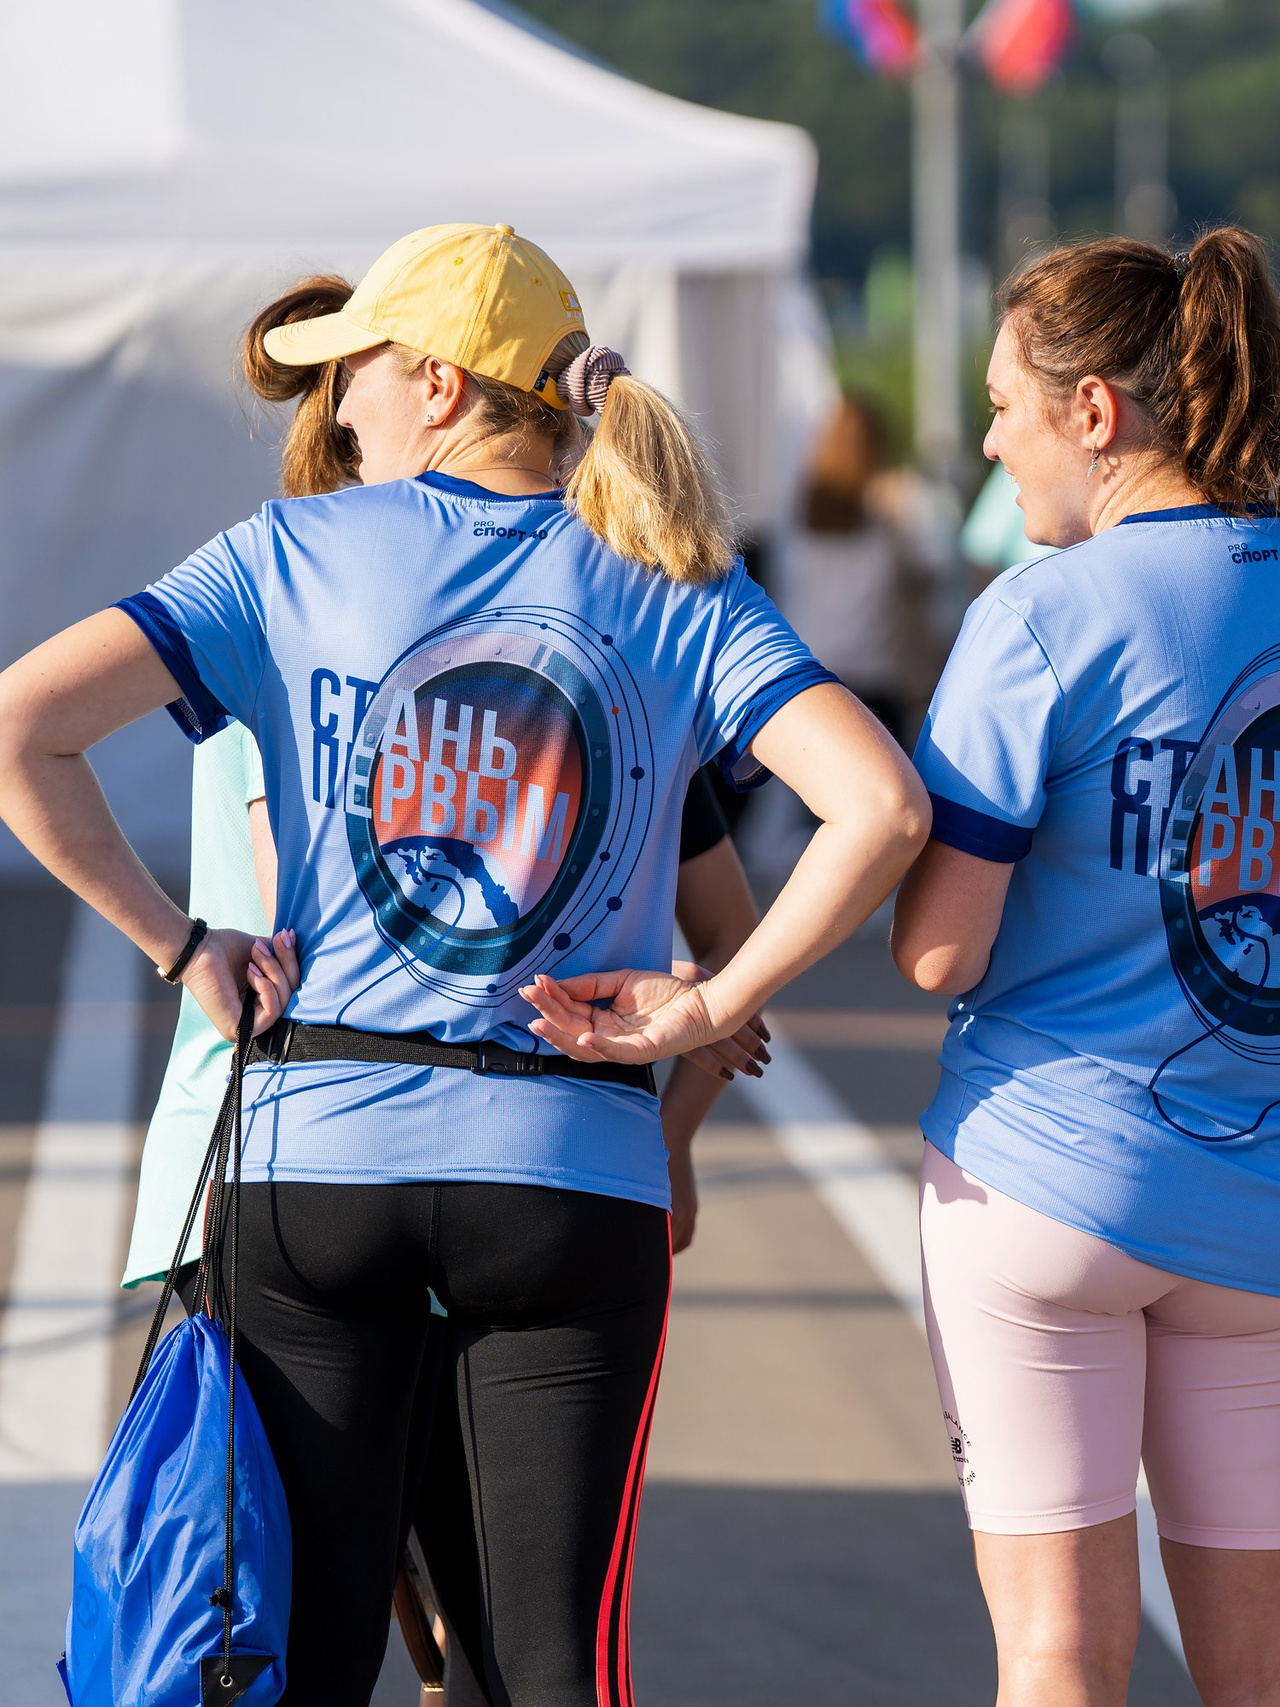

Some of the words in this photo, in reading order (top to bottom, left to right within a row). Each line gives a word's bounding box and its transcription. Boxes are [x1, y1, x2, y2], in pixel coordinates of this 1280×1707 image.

[473, 527, 526, 541] СПОРТ
[529, 529, 548, 540] 40
[1227, 542, 1248, 553] PRO
[1231, 549, 1279, 564] СПОРТ
[310, 667, 518, 781] СТАНЬ
[312, 727, 571, 864] ПЕРВЫМ
